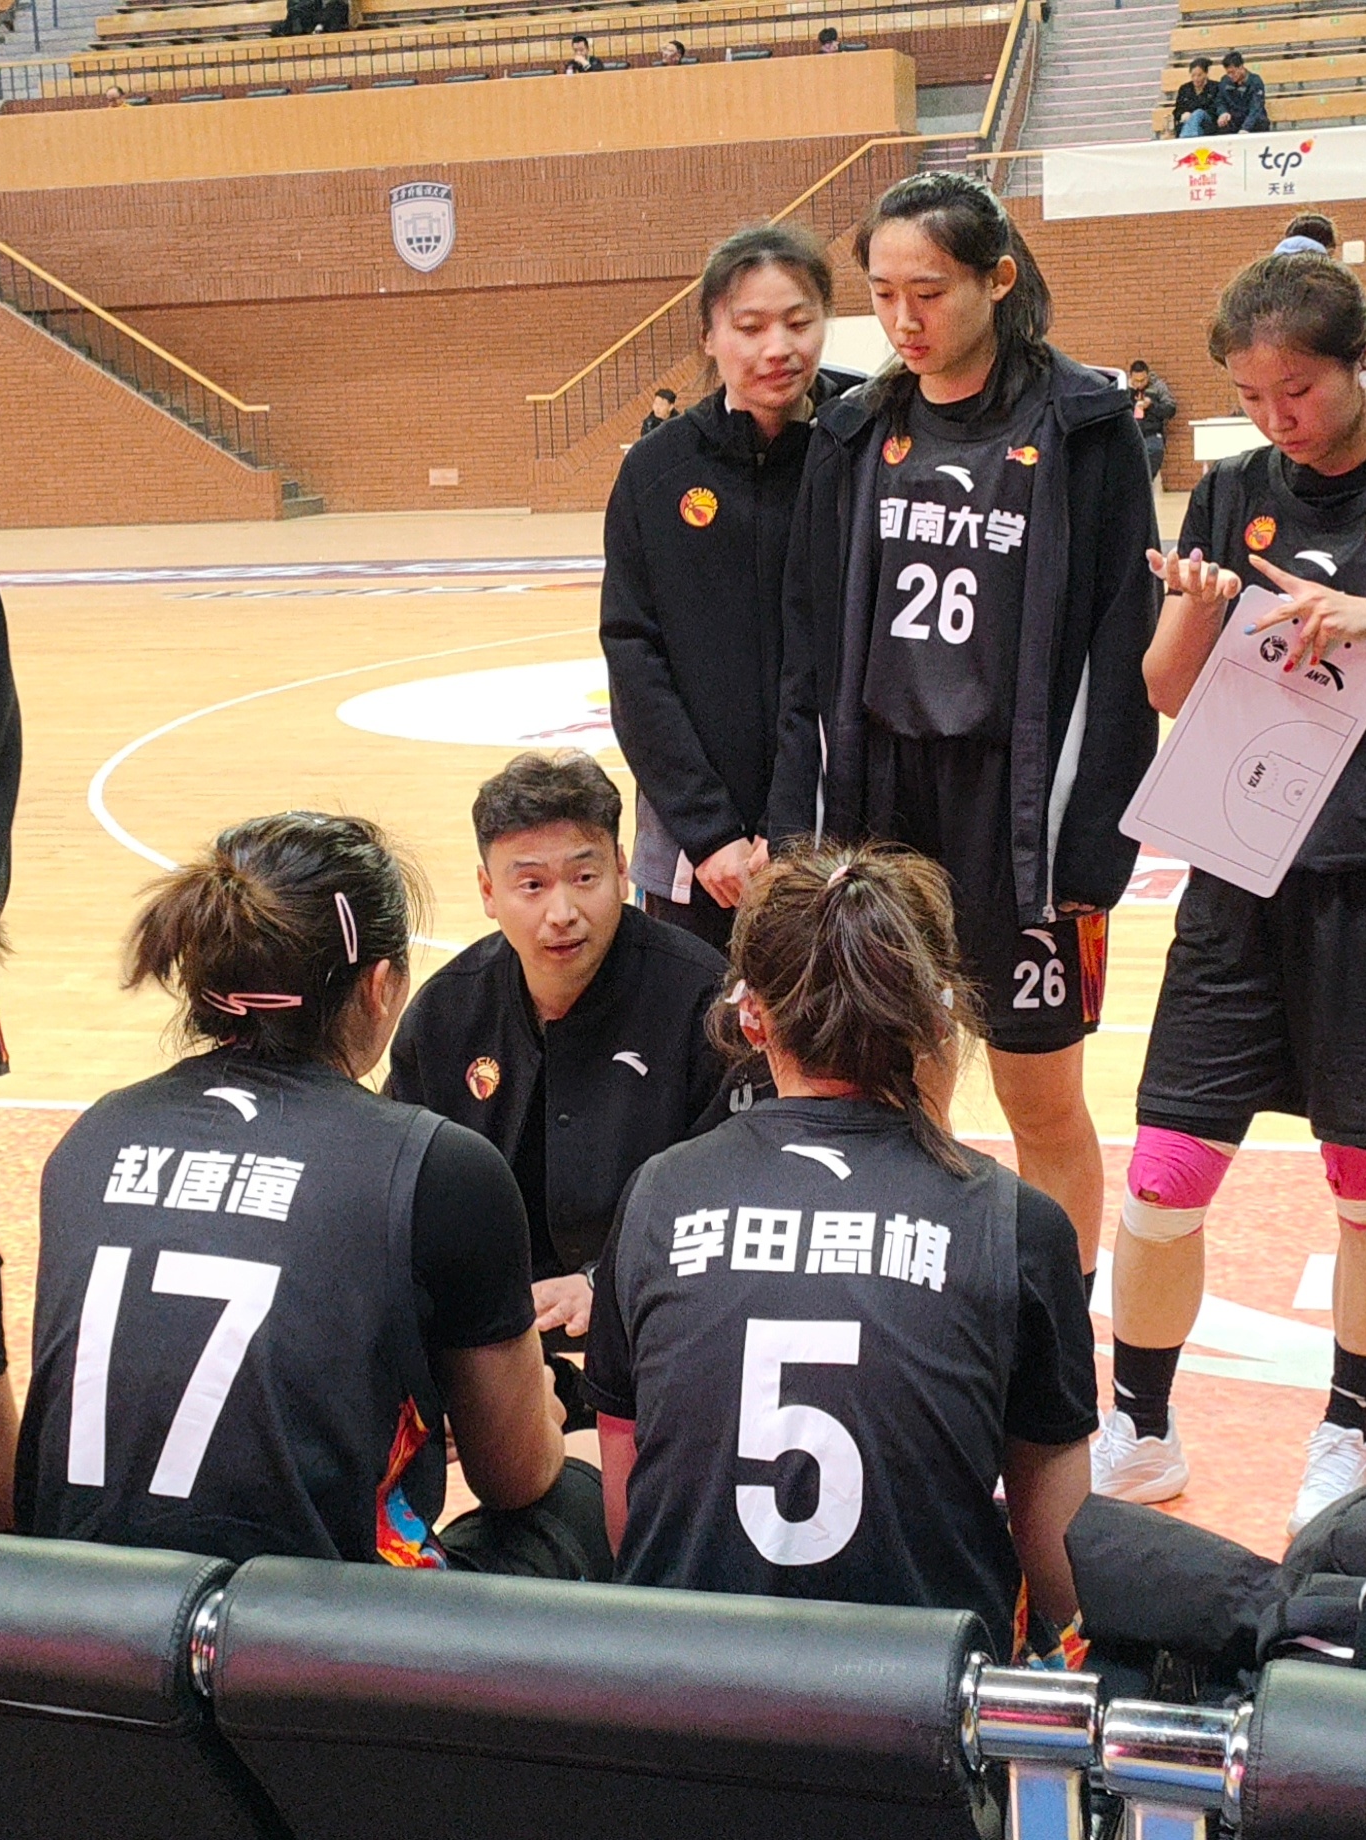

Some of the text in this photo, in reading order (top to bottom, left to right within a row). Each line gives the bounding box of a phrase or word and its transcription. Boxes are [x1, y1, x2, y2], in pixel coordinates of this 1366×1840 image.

[1258, 146, 1303, 176] tcp
[1189, 188, 1217, 201] 红牛
[1268, 182, 1296, 196] 天丝
[891, 563, 977, 644] 26
[1304, 669, 1331, 687] ANTA
[1247, 761, 1266, 788] ANTA
[1013, 959, 1066, 1009] 26
[103, 1145, 305, 1222] 赵唐潼
[670, 1206, 951, 1292] 李田思棋
[68, 1246, 281, 1498] 17
[736, 1318, 863, 1565] 5
